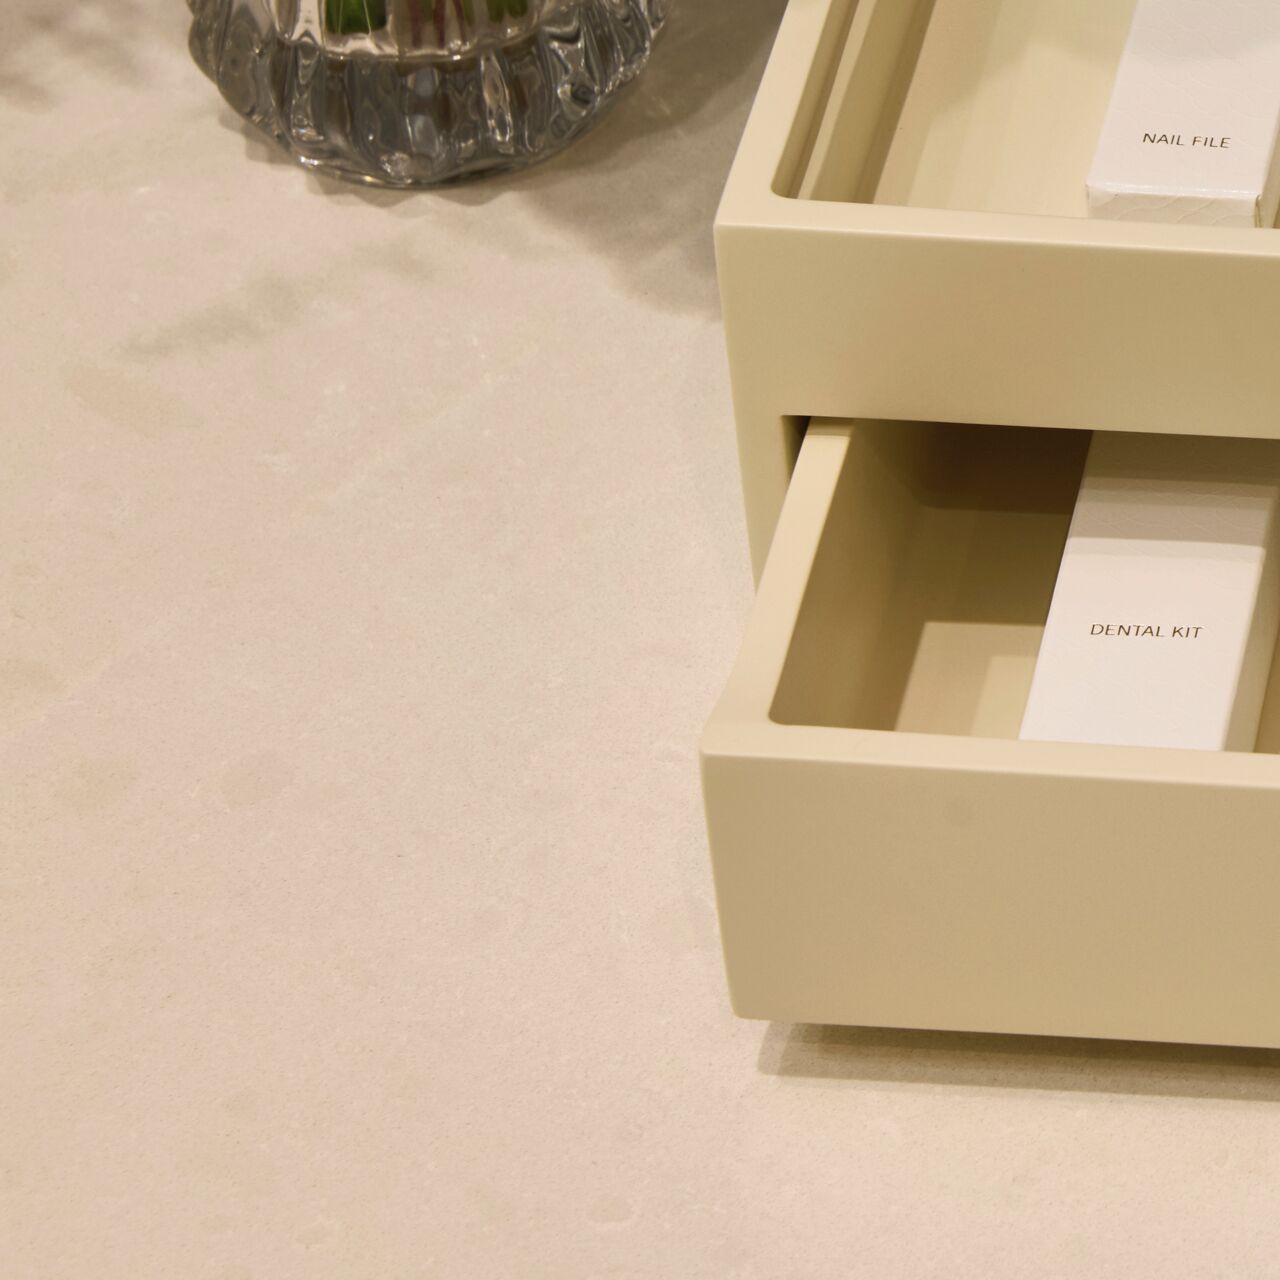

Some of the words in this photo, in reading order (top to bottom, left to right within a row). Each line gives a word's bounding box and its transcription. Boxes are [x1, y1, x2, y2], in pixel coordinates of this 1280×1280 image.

[1142, 132, 1185, 147] NAIL
[1191, 135, 1232, 149] FILE
[1089, 622, 1166, 638] DENTAL
[1170, 624, 1204, 639] KIT
